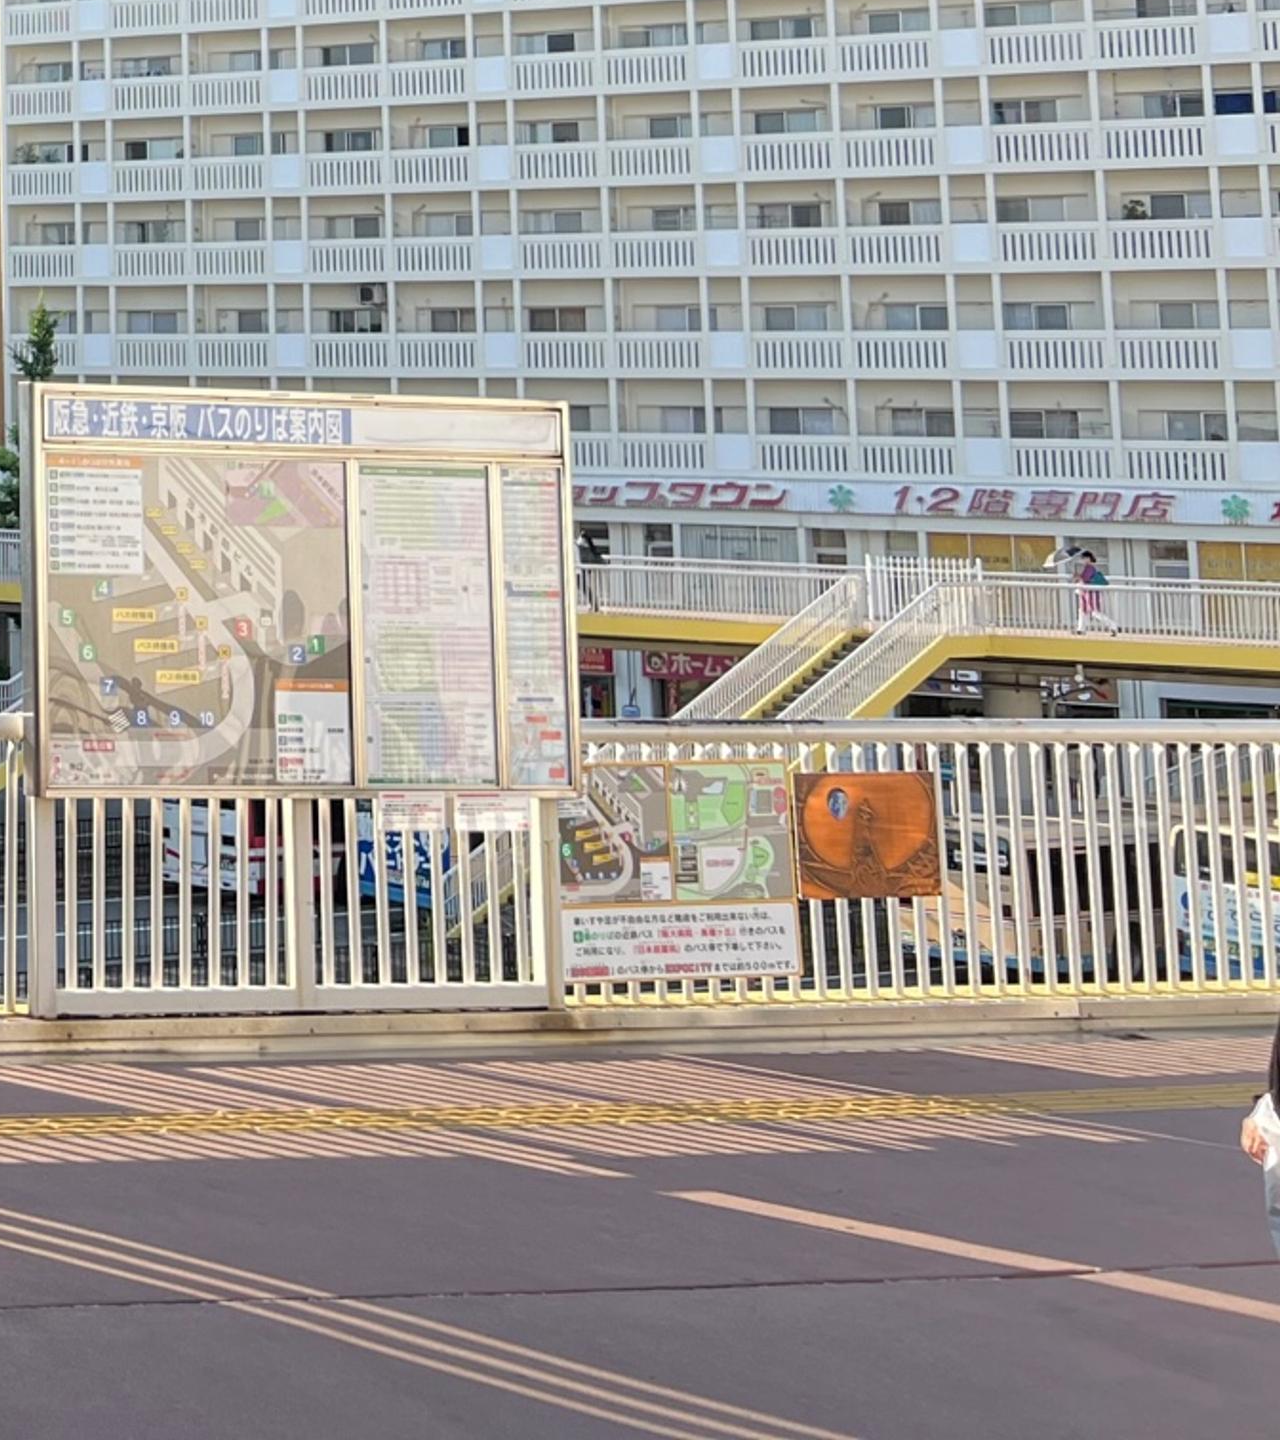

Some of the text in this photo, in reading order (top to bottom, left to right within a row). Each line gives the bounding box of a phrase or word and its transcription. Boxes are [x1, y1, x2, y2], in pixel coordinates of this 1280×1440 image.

[52, 399, 343, 444] 阪急・近鉄・京阪 バスのりば案内図
[98, 580, 108, 595] 4
[62, 609, 72, 624] 5
[238, 621, 248, 637] 3
[82, 644, 93, 660] 6
[292, 645, 304, 661] 2
[312, 637, 319, 653] 1
[103, 679, 115, 694] 7
[136, 710, 147, 725] 8
[169, 710, 180, 726] 9
[200, 711, 214, 726] 10
